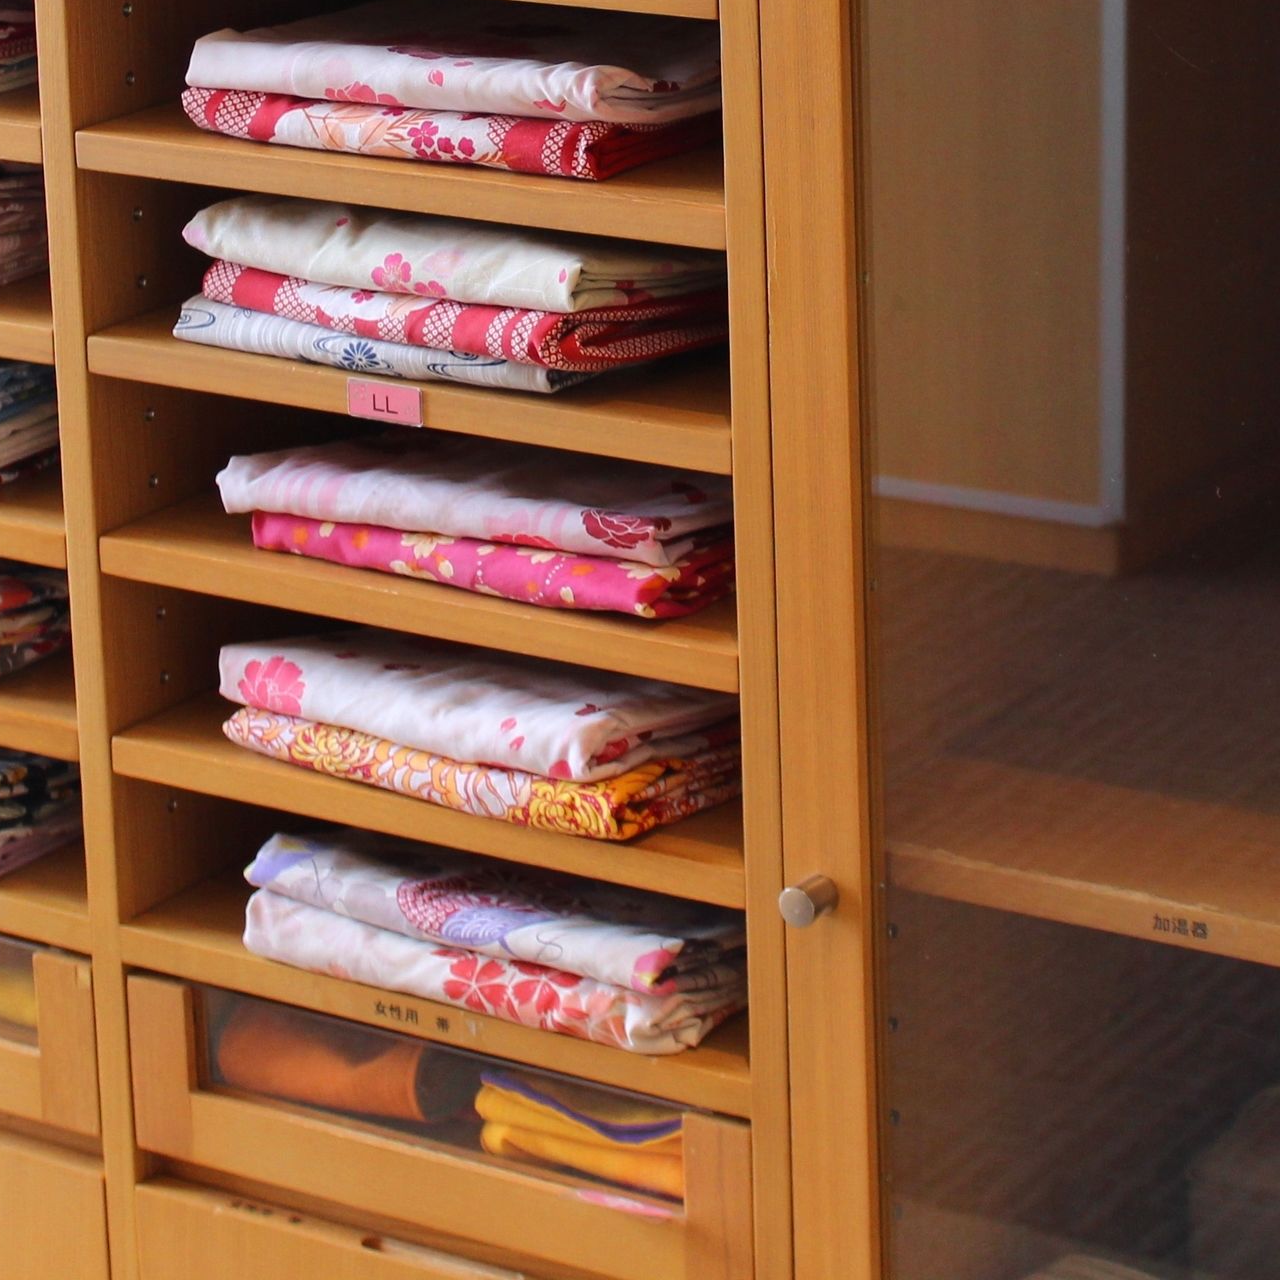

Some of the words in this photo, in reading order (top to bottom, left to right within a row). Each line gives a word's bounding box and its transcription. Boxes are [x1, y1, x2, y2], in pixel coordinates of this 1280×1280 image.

[372, 393, 399, 415] LL
[374, 1001, 419, 1025] 女性用
